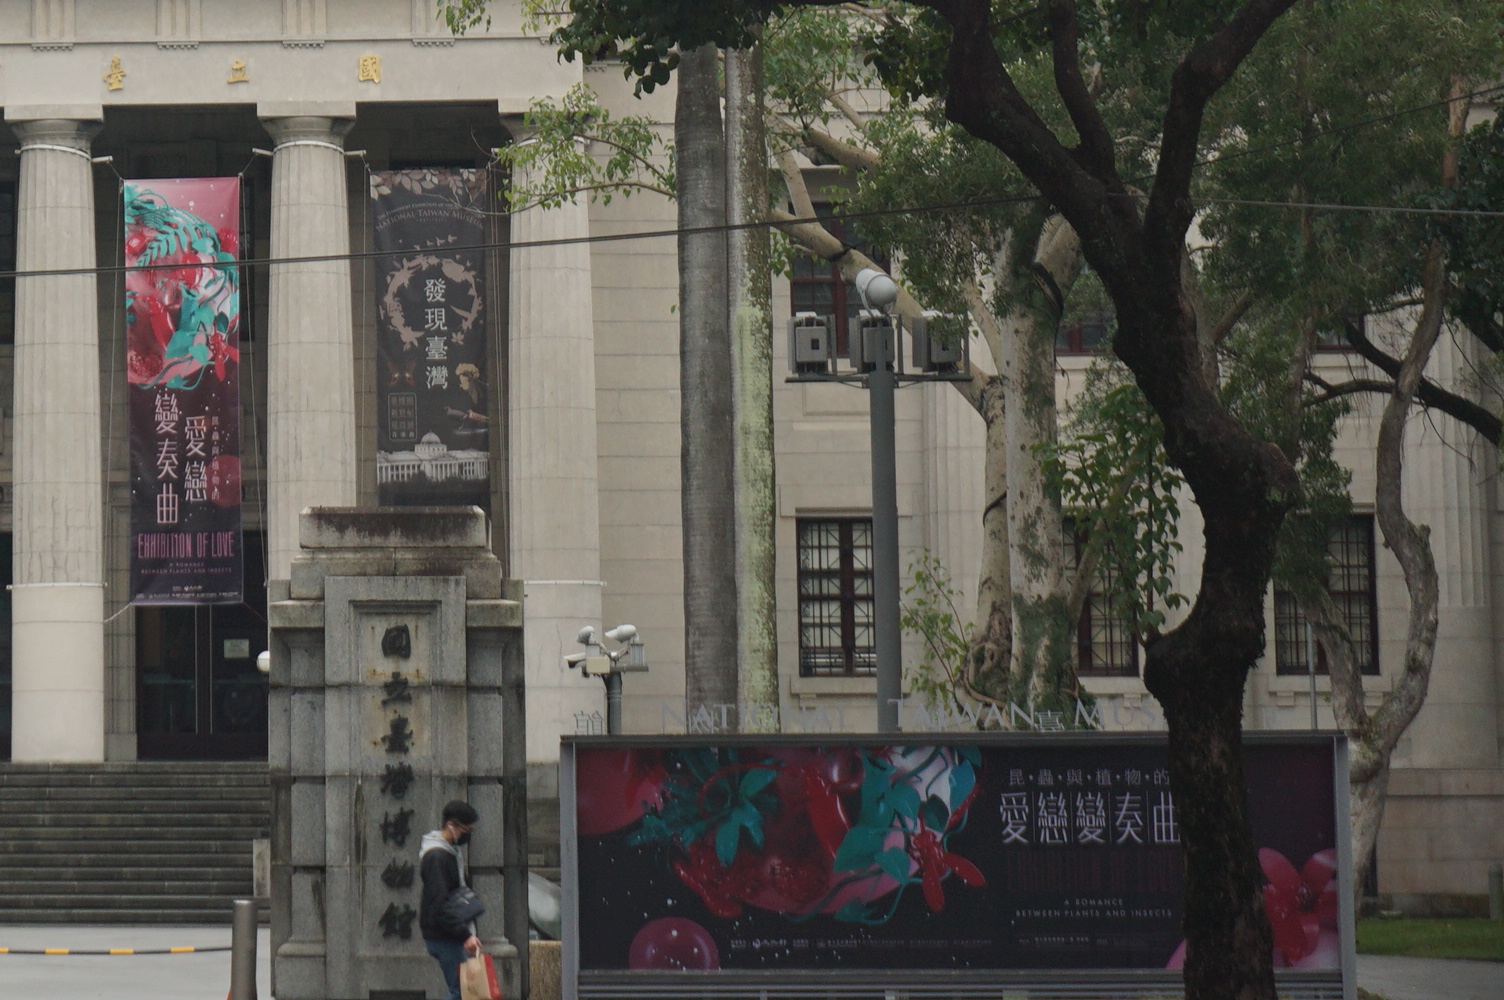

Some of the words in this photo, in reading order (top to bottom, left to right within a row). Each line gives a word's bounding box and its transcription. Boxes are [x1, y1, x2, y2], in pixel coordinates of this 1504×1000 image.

[376, 210, 415, 232] NATIONAL
[418, 209, 450, 217] TAIWAN
[423, 278, 449, 390] 發現臺灣
[154, 392, 179, 524] 變奏曲
[137, 532, 193, 559] EXHIBITION
[196, 532, 210, 558] OF
[211, 531, 236, 557] LOVE
[887, 698, 1035, 731] TAIWAN
[1015, 909, 1061, 917] BETWEEN
[1064, 909, 1100, 917] PLANTS
[1105, 909, 1126, 917] AND
[1131, 909, 1173, 917] INSECTS
[1075, 898, 1124, 906] ROMANCE
